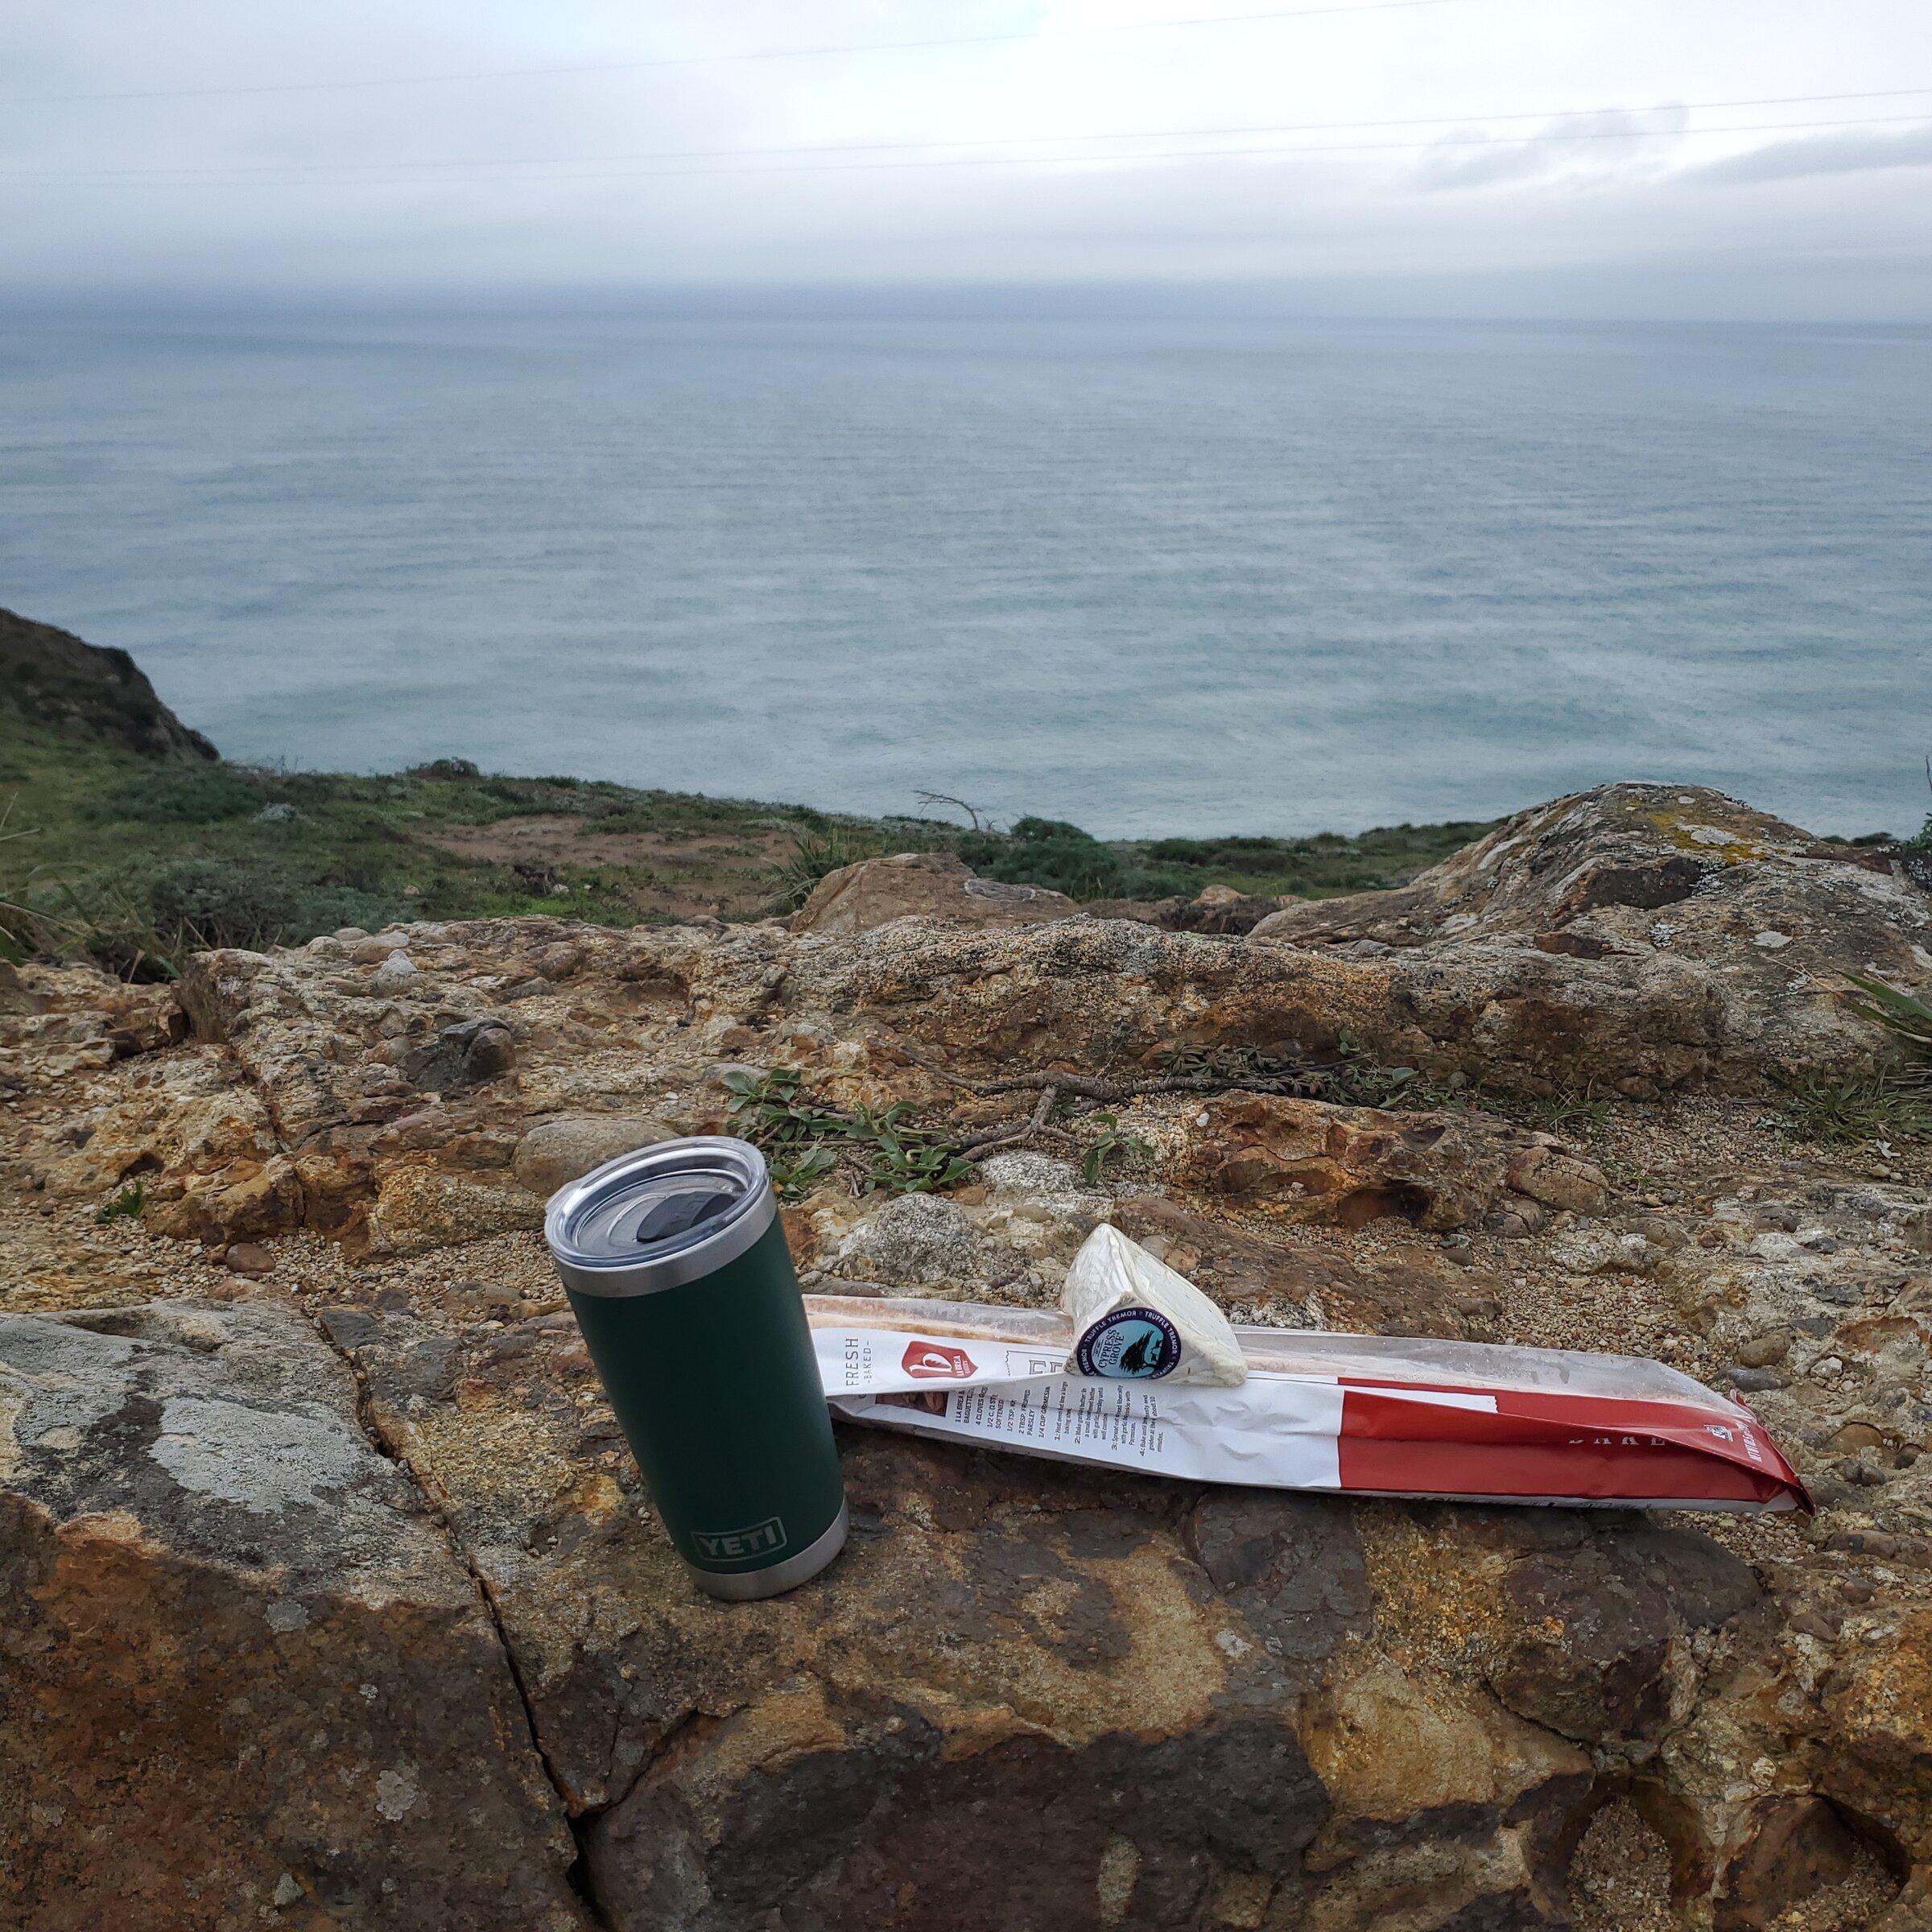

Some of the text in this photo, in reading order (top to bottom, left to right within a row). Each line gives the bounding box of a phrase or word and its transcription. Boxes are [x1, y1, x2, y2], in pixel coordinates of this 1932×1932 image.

[1087, 1321, 1107, 1344] TRUFFLE
[1108, 1311, 1137, 1323] TREMOR
[1145, 1311, 1169, 1329] TRUFFLE
[1167, 1328, 1178, 1354] TREMOR
[1098, 1329, 1117, 1368] CYPRESS
[845, 1337, 859, 1386] FRESH
[1026, 1409, 1034, 1436] PARSLEY
[698, 1525, 778, 1556] YETI
